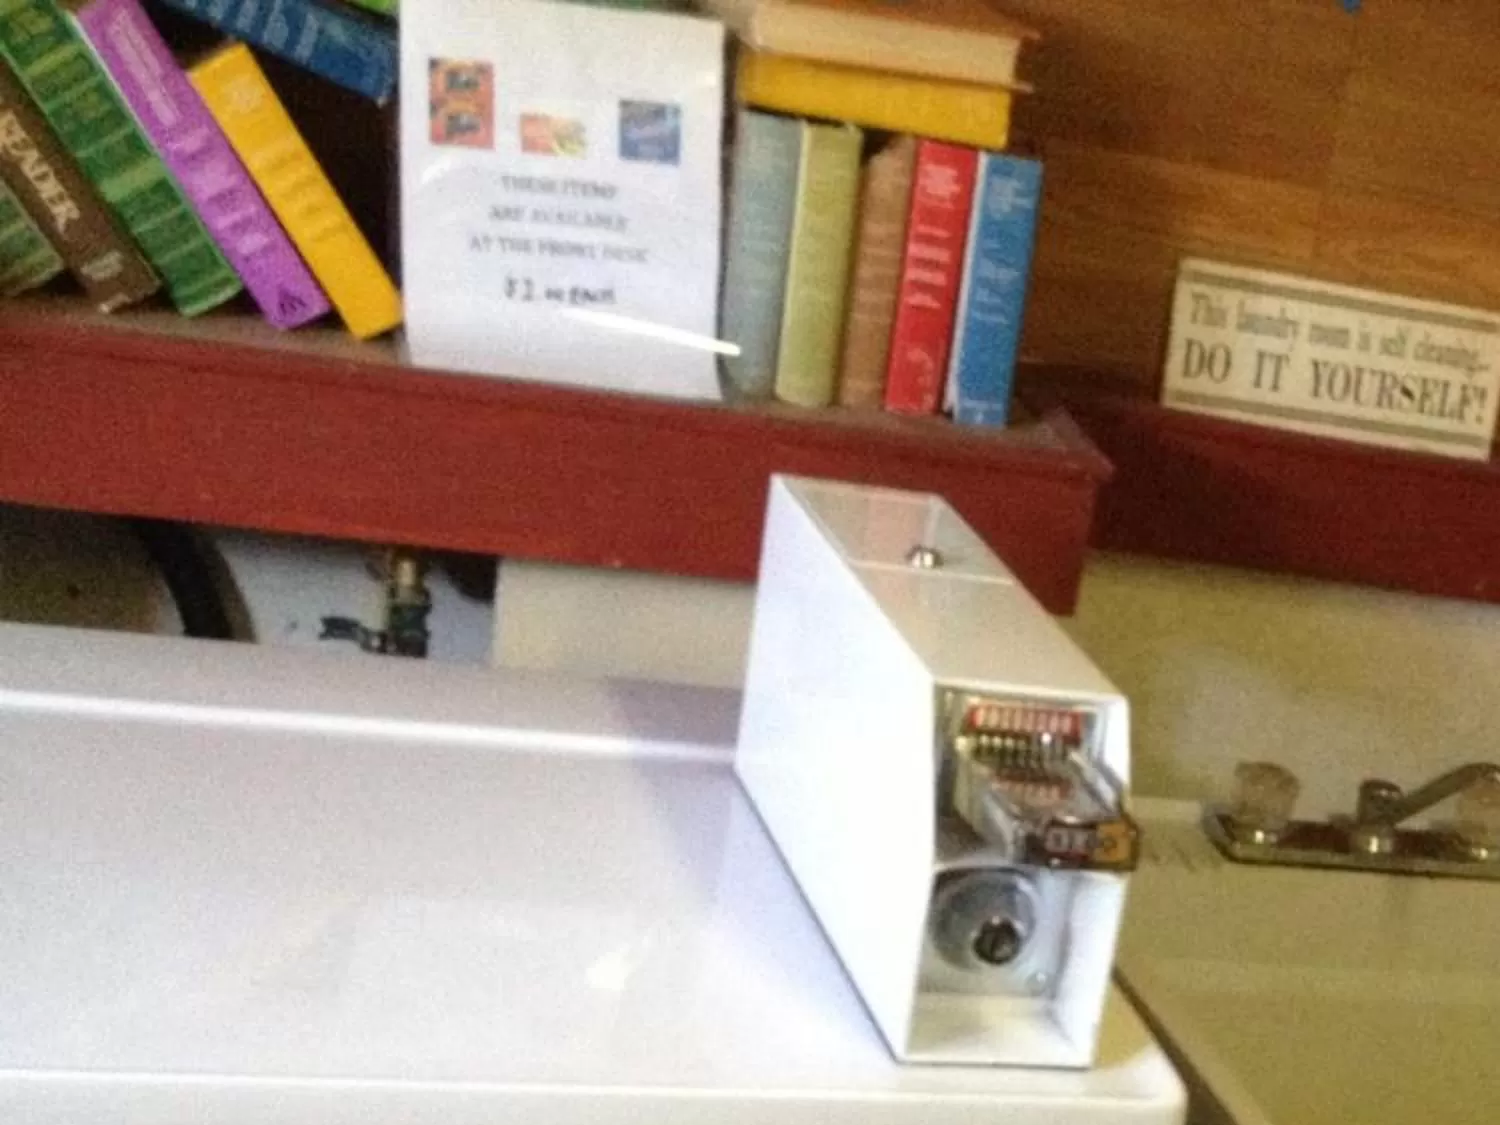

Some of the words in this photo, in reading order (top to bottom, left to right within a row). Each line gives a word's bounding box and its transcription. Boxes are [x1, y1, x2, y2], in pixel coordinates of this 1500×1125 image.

[470, 234, 492, 252] AT
[498, 235, 533, 254] THE
[537, 239, 595, 260] FRONT
[1182, 338, 1232, 384] DO
[1252, 350, 1290, 392] IT
[1308, 357, 1488, 425] YOURSELF!
